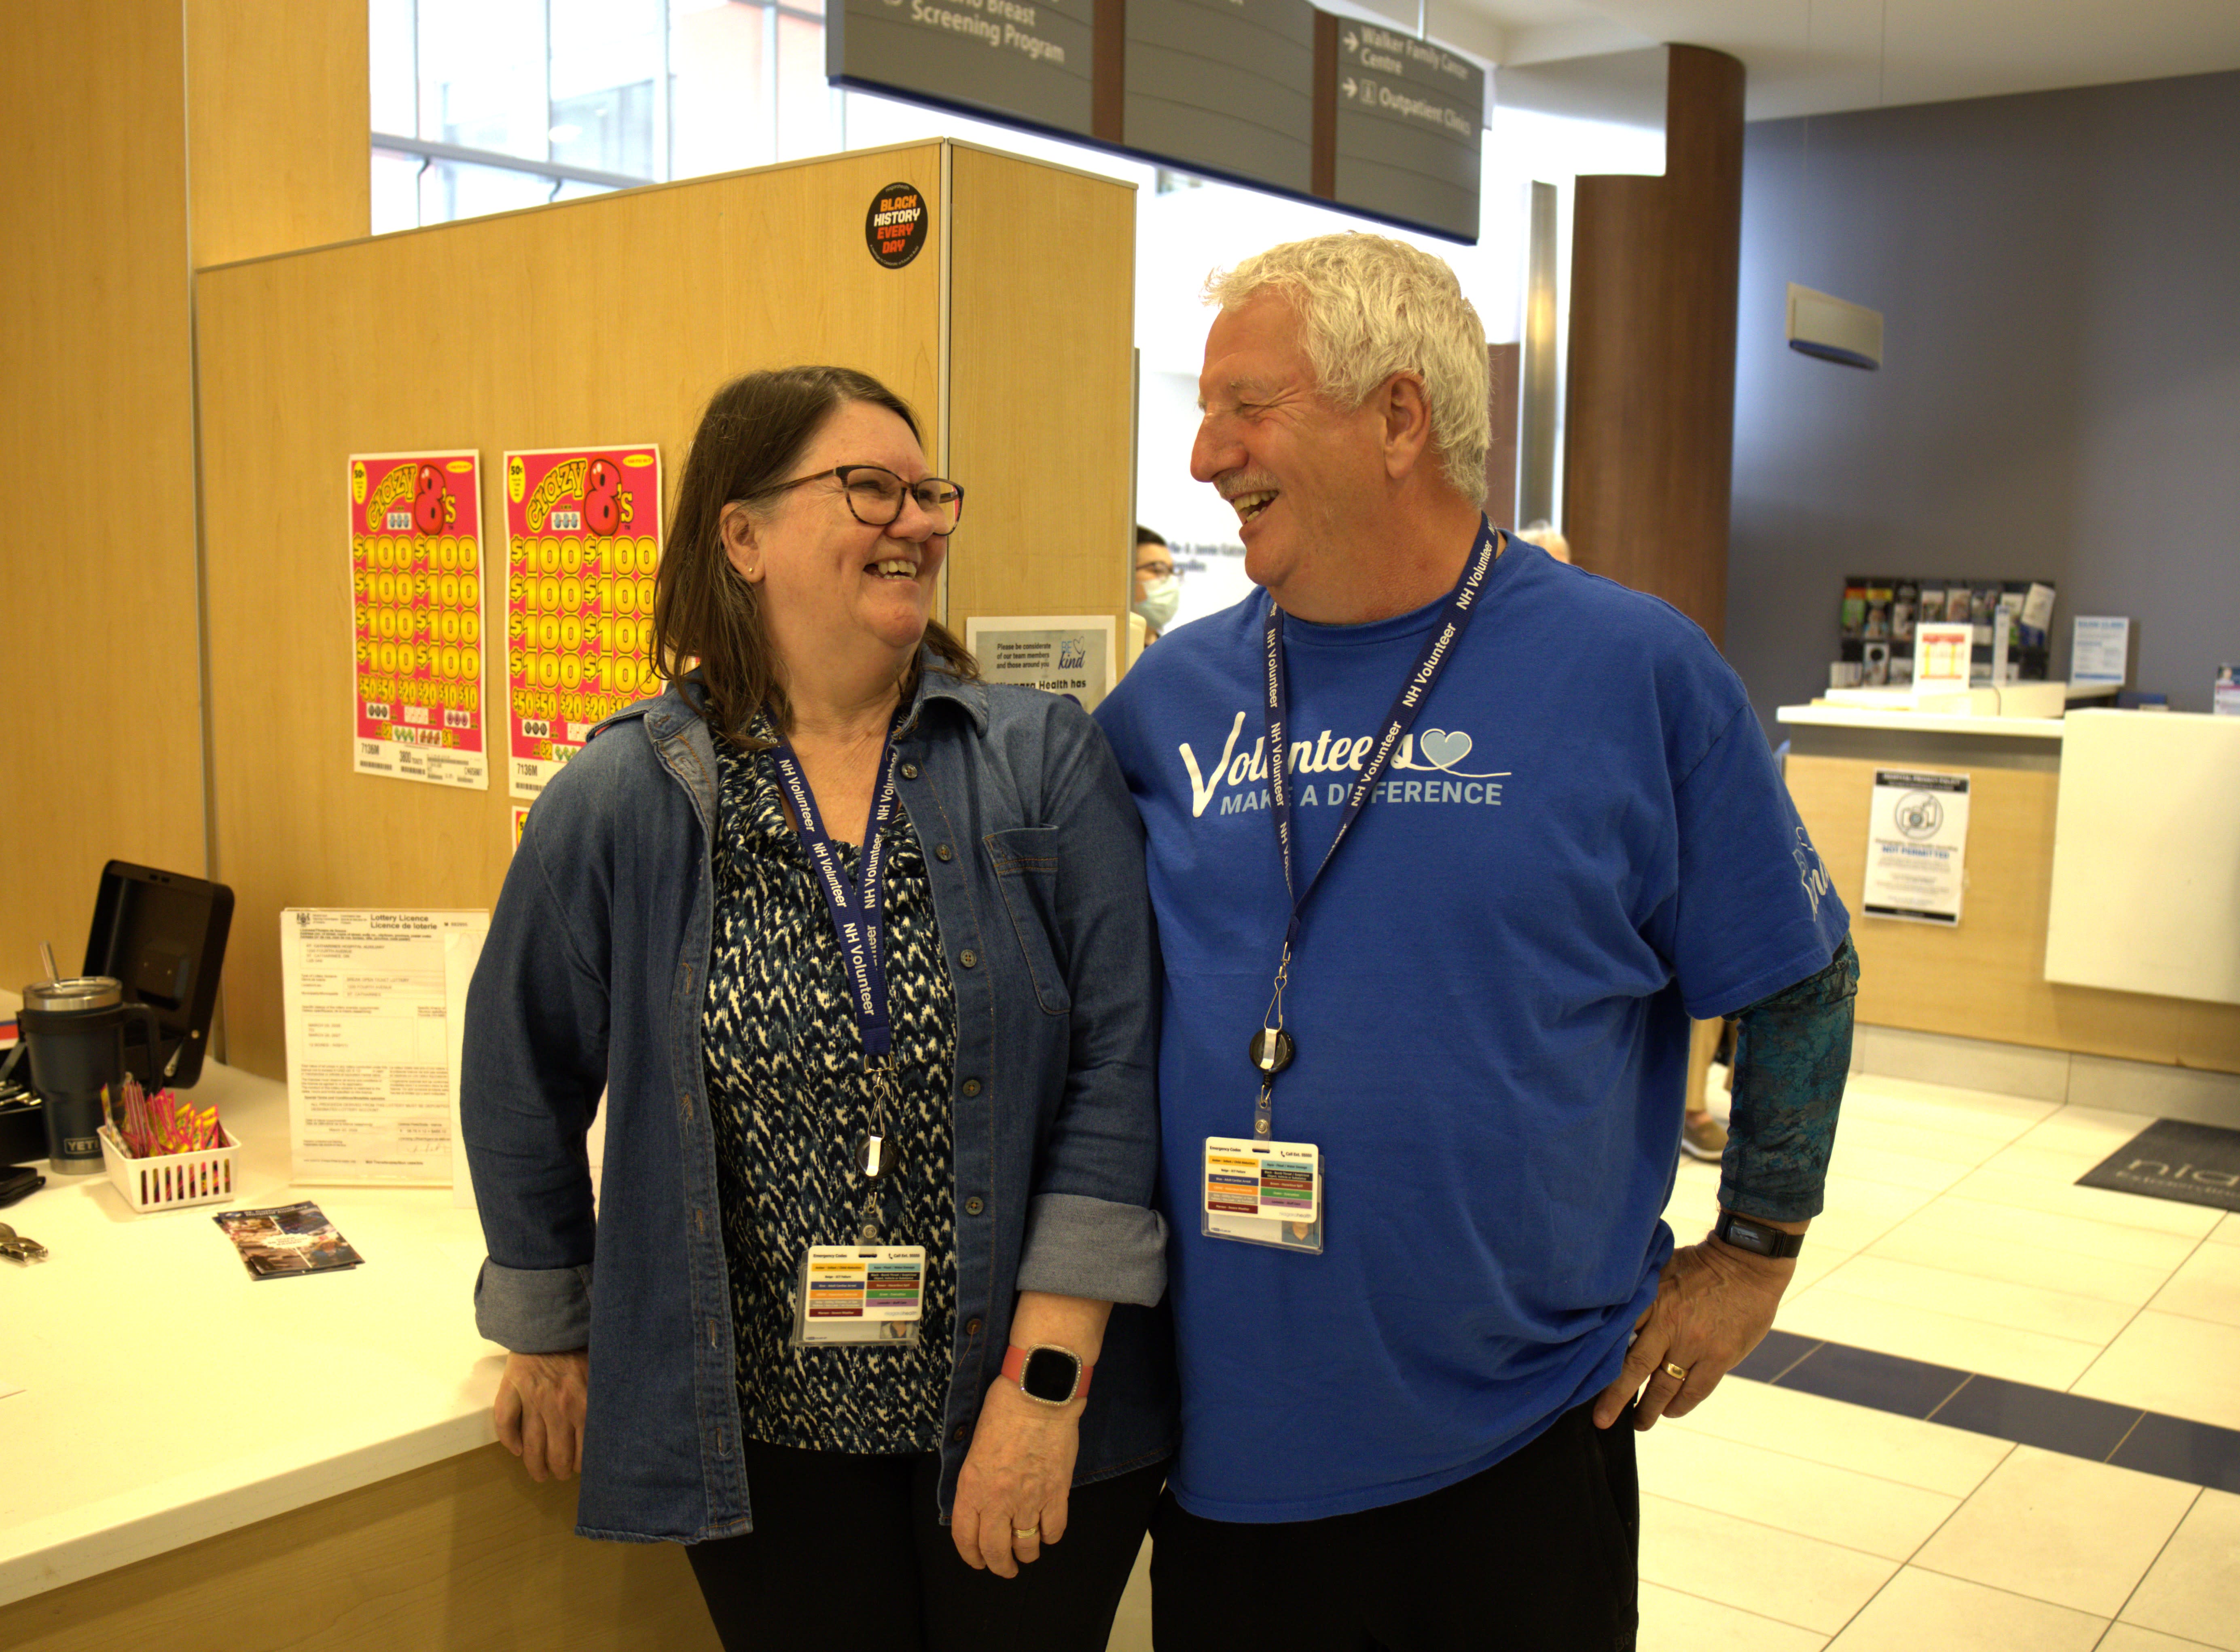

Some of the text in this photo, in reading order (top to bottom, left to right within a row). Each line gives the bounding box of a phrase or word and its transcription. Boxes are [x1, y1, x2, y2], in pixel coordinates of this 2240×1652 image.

[911, 0, 1065, 63] Screening Program
[1360, 48, 1403, 75] Centre
[1405, 38, 1439, 70] Family
[1378, 87, 1443, 123] Outpatient
[874, 208, 921, 226] HISTORY
[881, 194, 917, 212] BLACK
[877, 223, 914, 239] EVERY
[882, 239, 906, 254] DAY
[353, 533, 478, 572] $100 $100
[510, 535, 658, 575] $100 $100
[354, 568, 479, 608] $100 $100
[510, 573, 582, 612] $100
[1456, 540, 1493, 610] NH Volunteer
[356, 603, 479, 644] $100 $100
[510, 611, 582, 651] $100
[1267, 628, 1276, 649] NH
[356, 637, 480, 681] $100 $100
[1058, 650, 1086, 670] kind
[1061, 641, 1072, 654] BE
[1402, 622, 1456, 707] NH Volunteer
[510, 648, 661, 695] $100 $100
[1039, 679, 1068, 689] Health
[1071, 679, 1086, 688] has
[1268, 648, 1278, 708] Volunteer
[359, 675, 478, 712] $50 $50 $20 $20 $10 $10
[512, 688, 534, 717] $50
[535, 690, 557, 720] $50
[560, 691, 582, 722] $20
[585, 692, 608, 723] $20
[540, 740, 552, 760] $2
[1271, 722, 1284, 807] NH Volunteer
[1351, 721, 1402, 807] NH Volunteer
[517, 763, 538, 776] 7136M
[779, 759, 815, 832] NH Volunteer
[876, 805, 890, 820] NH
[1220, 785, 1293, 816] MAK
[1300, 785, 1318, 806] A
[1280, 821, 1288, 844] NH
[865, 833, 883, 886] Volunteer
[1882, 846, 1950, 859] NOT PERMITTED
[812, 842, 847, 908] NH Volunteer
[864, 888, 875, 909] NH
[371, 914, 396, 922] Lottery
[843, 922, 860, 943] NH
[851, 945, 874, 1015] Volunteer
[67, 1139, 98, 1151] YETI
